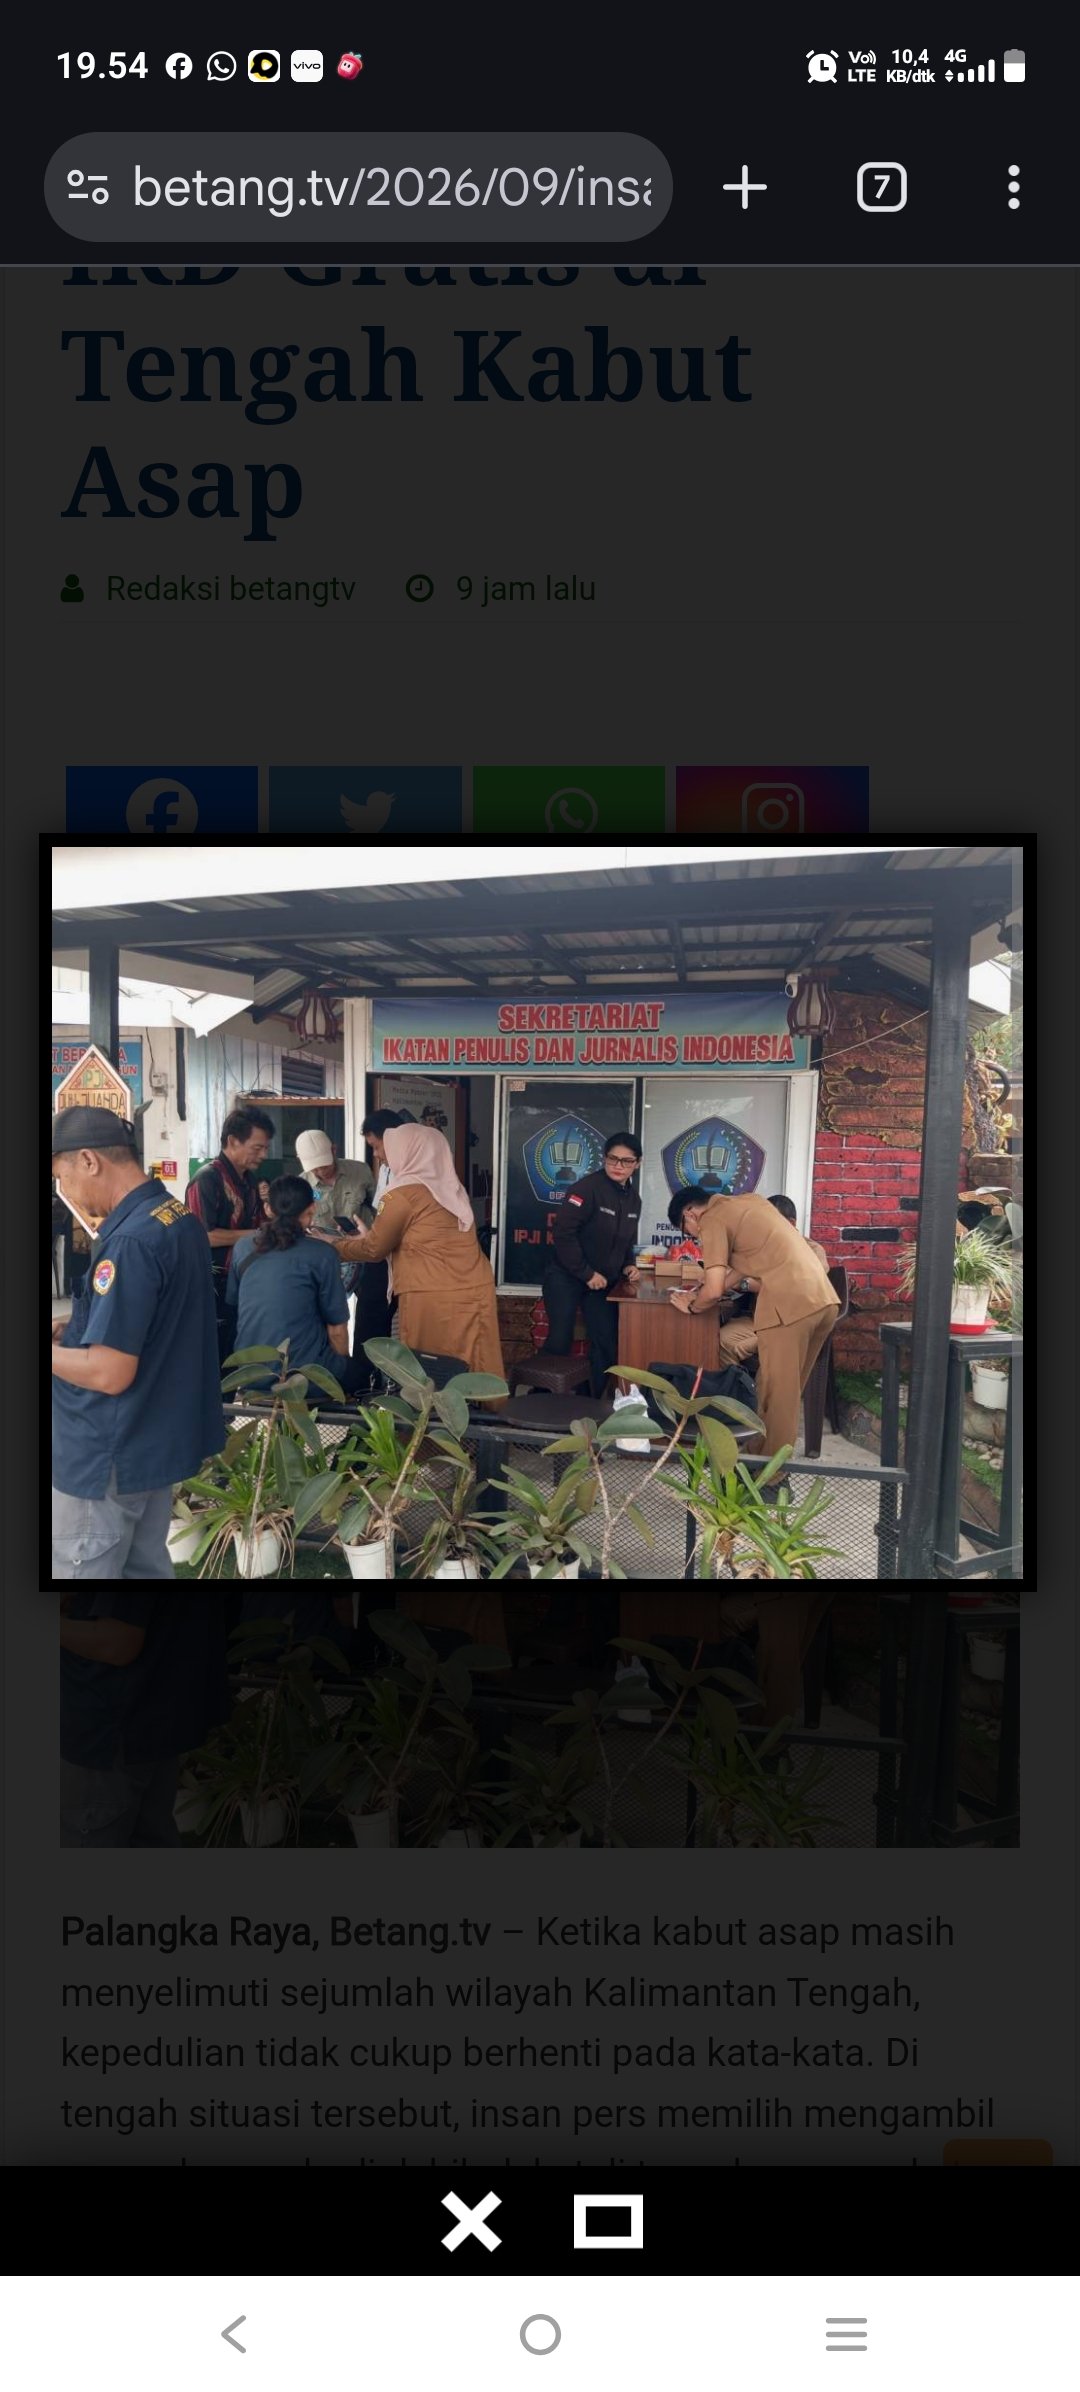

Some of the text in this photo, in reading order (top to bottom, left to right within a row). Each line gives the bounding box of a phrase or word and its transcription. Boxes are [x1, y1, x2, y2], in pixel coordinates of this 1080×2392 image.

[58, 52, 148, 79] 19.54
[293, 62, 322, 70] vivo
[892, 49, 929, 66] 10,4
[944, 49, 967, 62] 4G
[848, 69, 876, 82] LTE
[887, 70, 936, 84] KB/dtk
[873, 174, 891, 200] 7
[60, 326, 753, 425] Tengah Kabut
[60, 446, 303, 542] Asap
[107, 575, 357, 608] Redaksi betangtv
[456, 575, 596, 608] 9 jam lalu
[498, 1002, 664, 1032] SEKRETARIAT
[382, 1034, 796, 1063] IKATAN PENULIS DAN JURNALIS INDONESIA
[514, 1229, 541, 1244] IPJI
[61, 1915, 219, 1954] Palangka
[230, 1916, 319, 1954] Raya,
[330, 1916, 492, 1954] Betang.tv
[537, 1916, 641, 1946] Ketika
[653, 1916, 747, 1946] kabut
[758, 1924, 840, 1954] asap
[851, 1916, 954, 1946] masih
[62, 1976, 920, 2015] menyelimuti sejumlah wilayah Kalimantan Tengah,
[62, 2036, 918, 2075] kepedulian tidak cukup berhenti pada kata-kata. Di
[61, 2097, 994, 2136] tengah situasi tersebut, insan pers memilih mengambil
